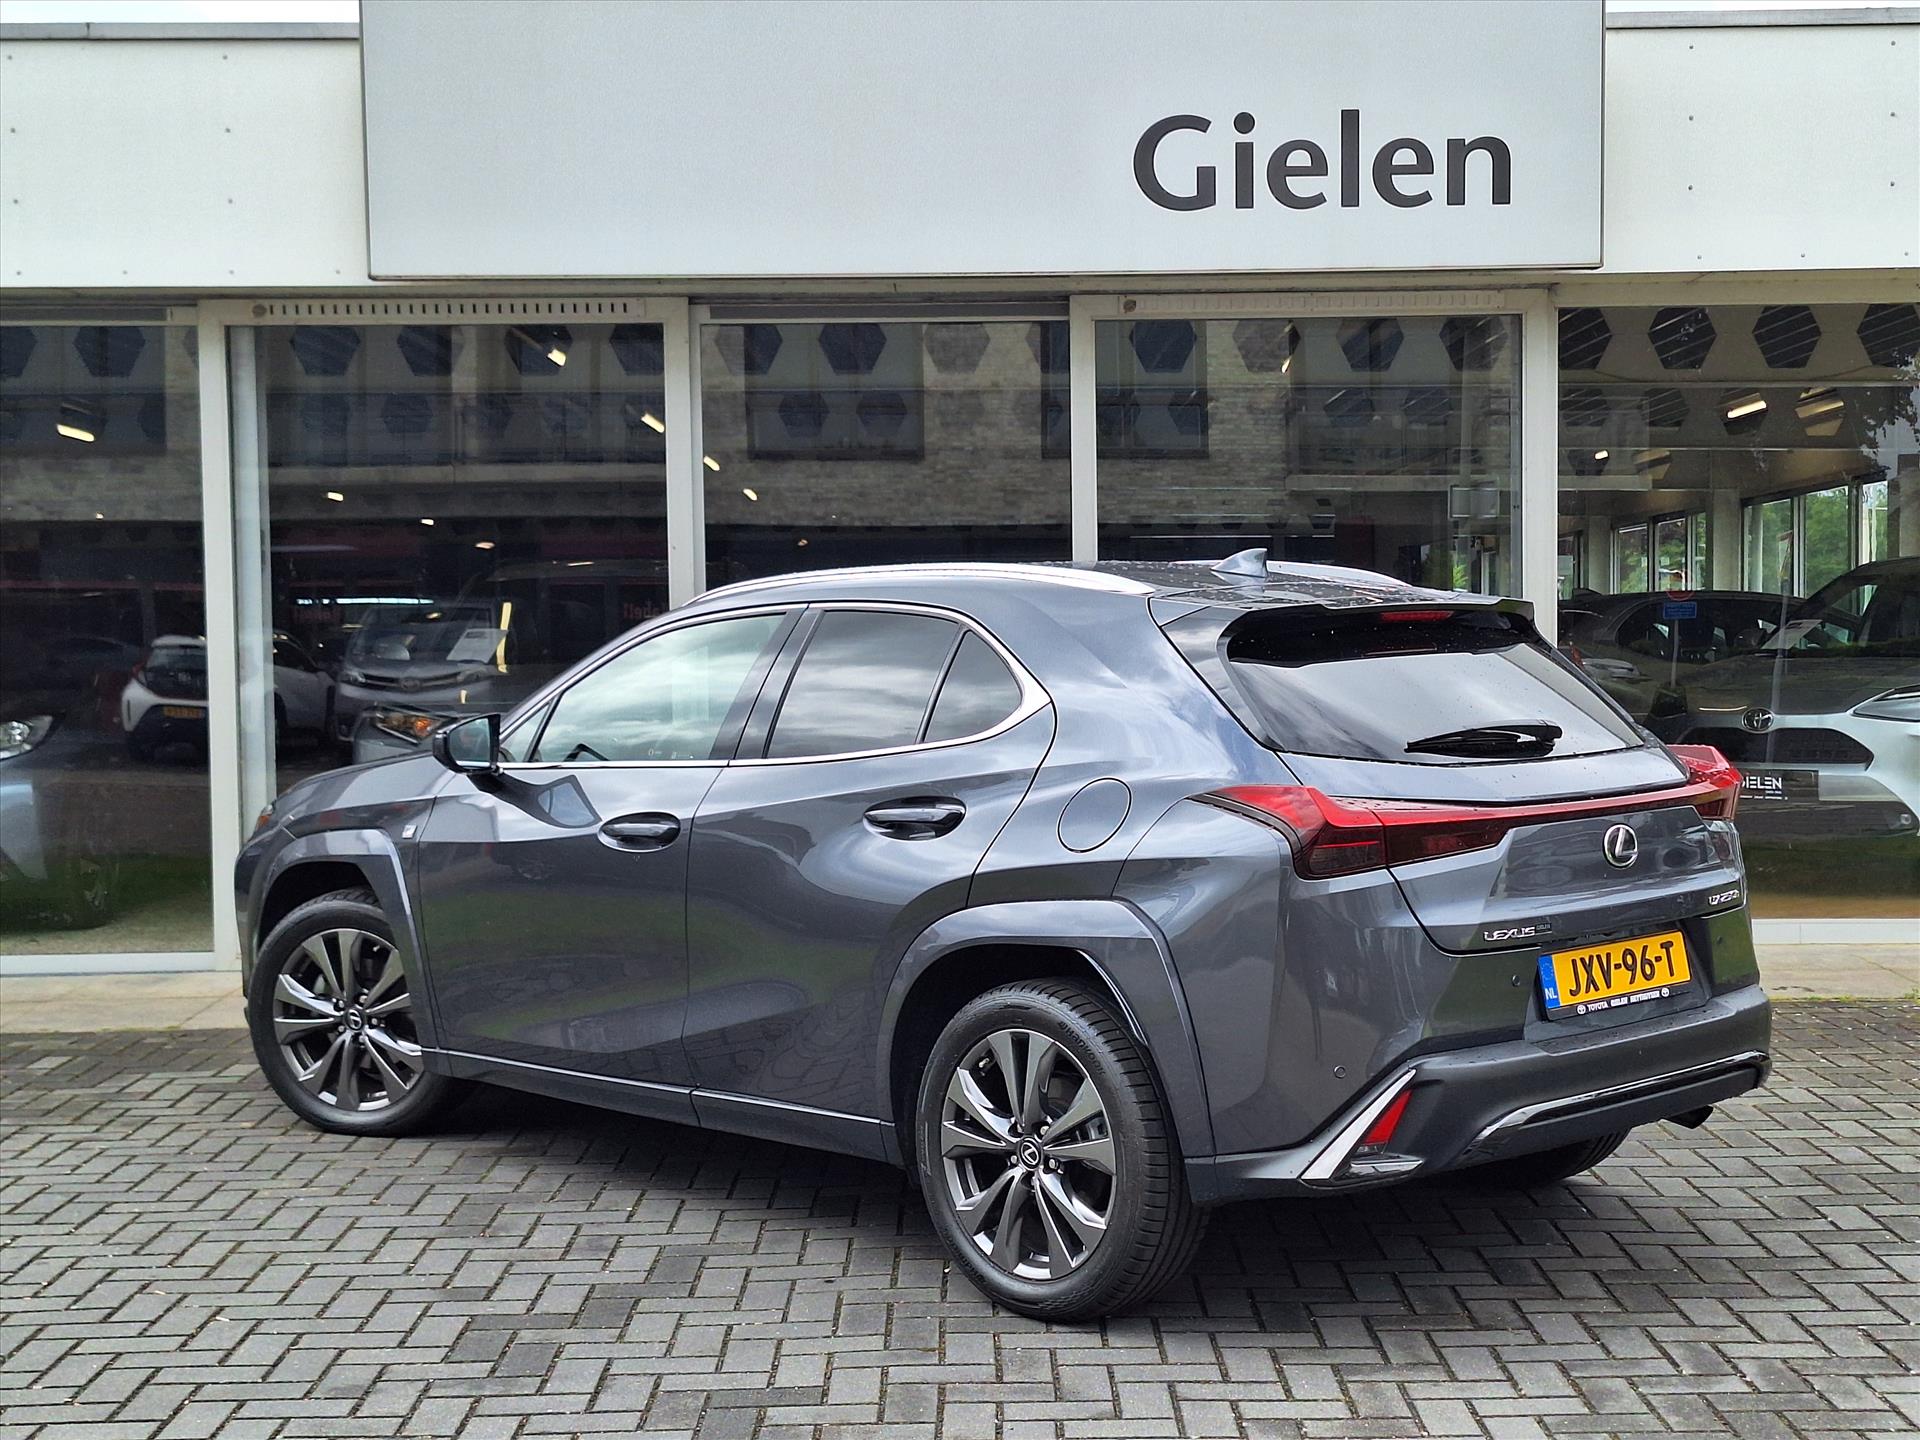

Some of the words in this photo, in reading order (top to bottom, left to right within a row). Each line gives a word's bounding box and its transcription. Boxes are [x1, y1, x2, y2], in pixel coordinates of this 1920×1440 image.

[1133, 109, 1511, 211] Gielen
[1742, 776, 1782, 790] IELEN
[1484, 926, 1536, 941] LEXUS
[1569, 940, 1674, 997] JXV-96-T
[1545, 987, 1558, 999] NL
